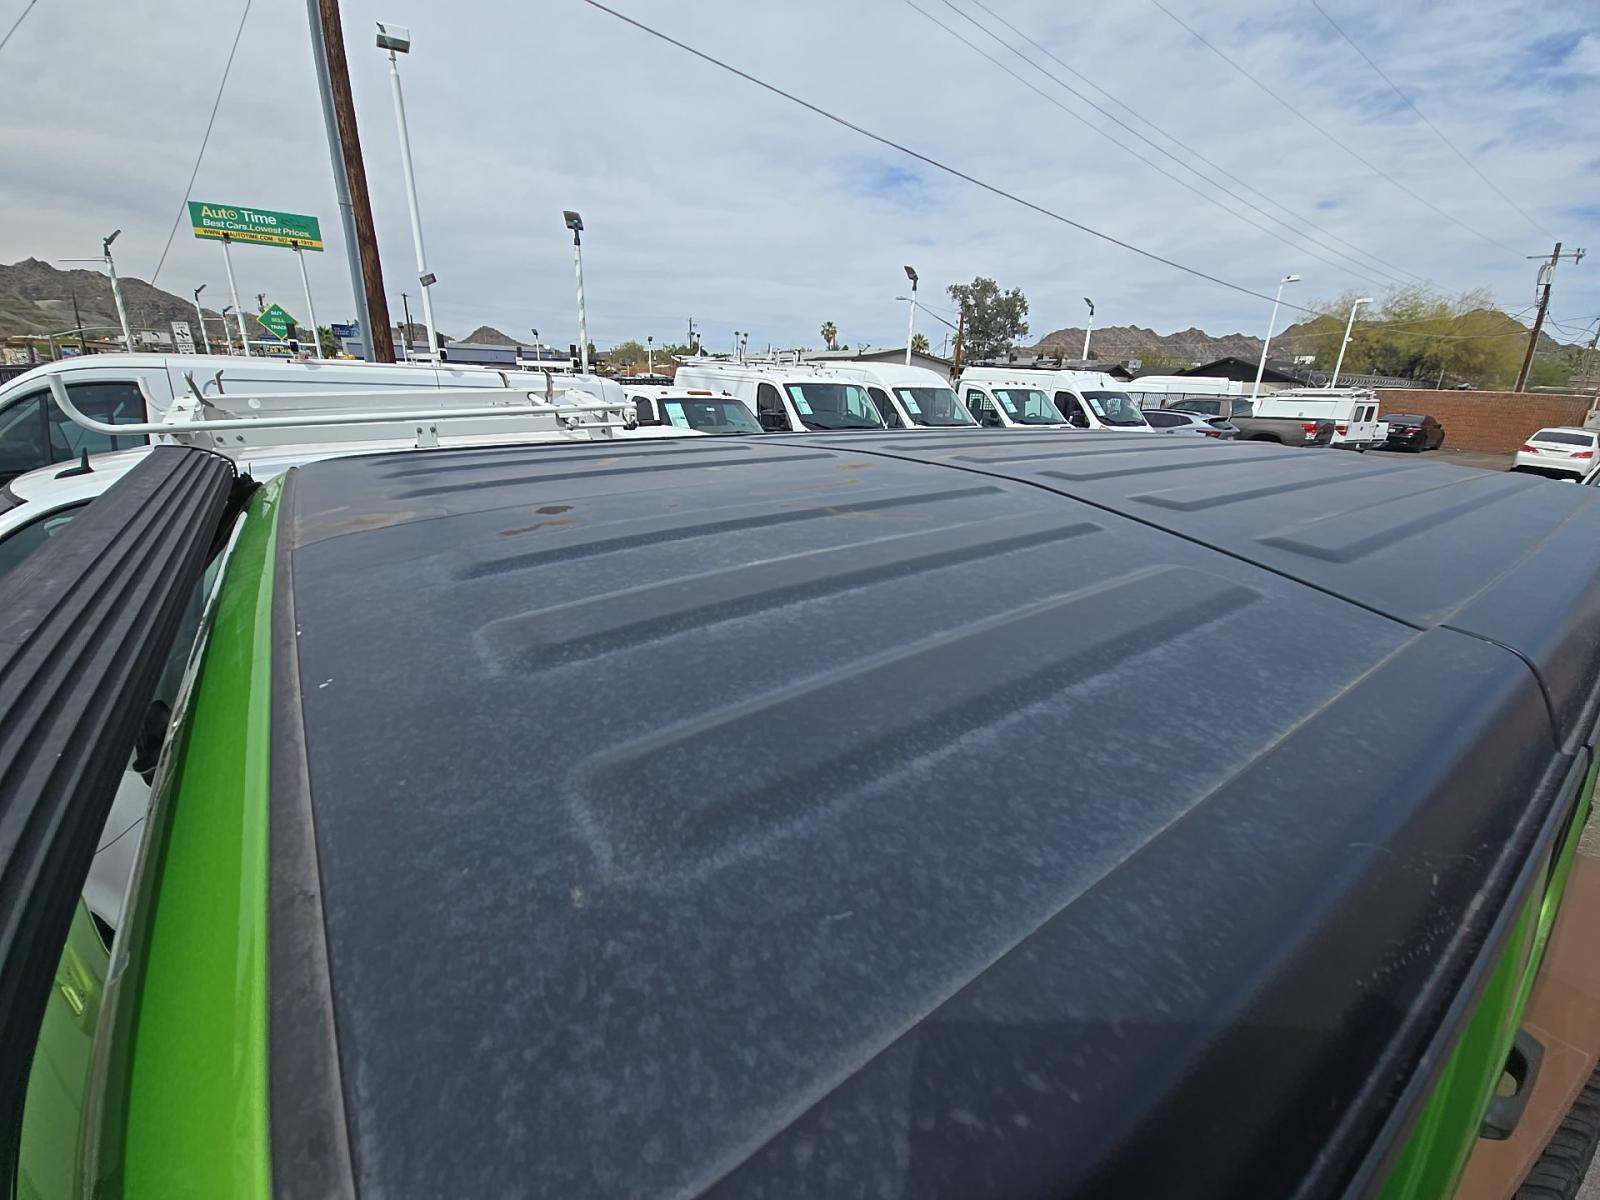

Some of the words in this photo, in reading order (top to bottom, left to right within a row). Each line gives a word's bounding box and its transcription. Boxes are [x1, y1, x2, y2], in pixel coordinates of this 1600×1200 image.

[201, 205, 238, 220] Auto
[240, 210, 277, 225] Time
[203, 218, 225, 228] Best
